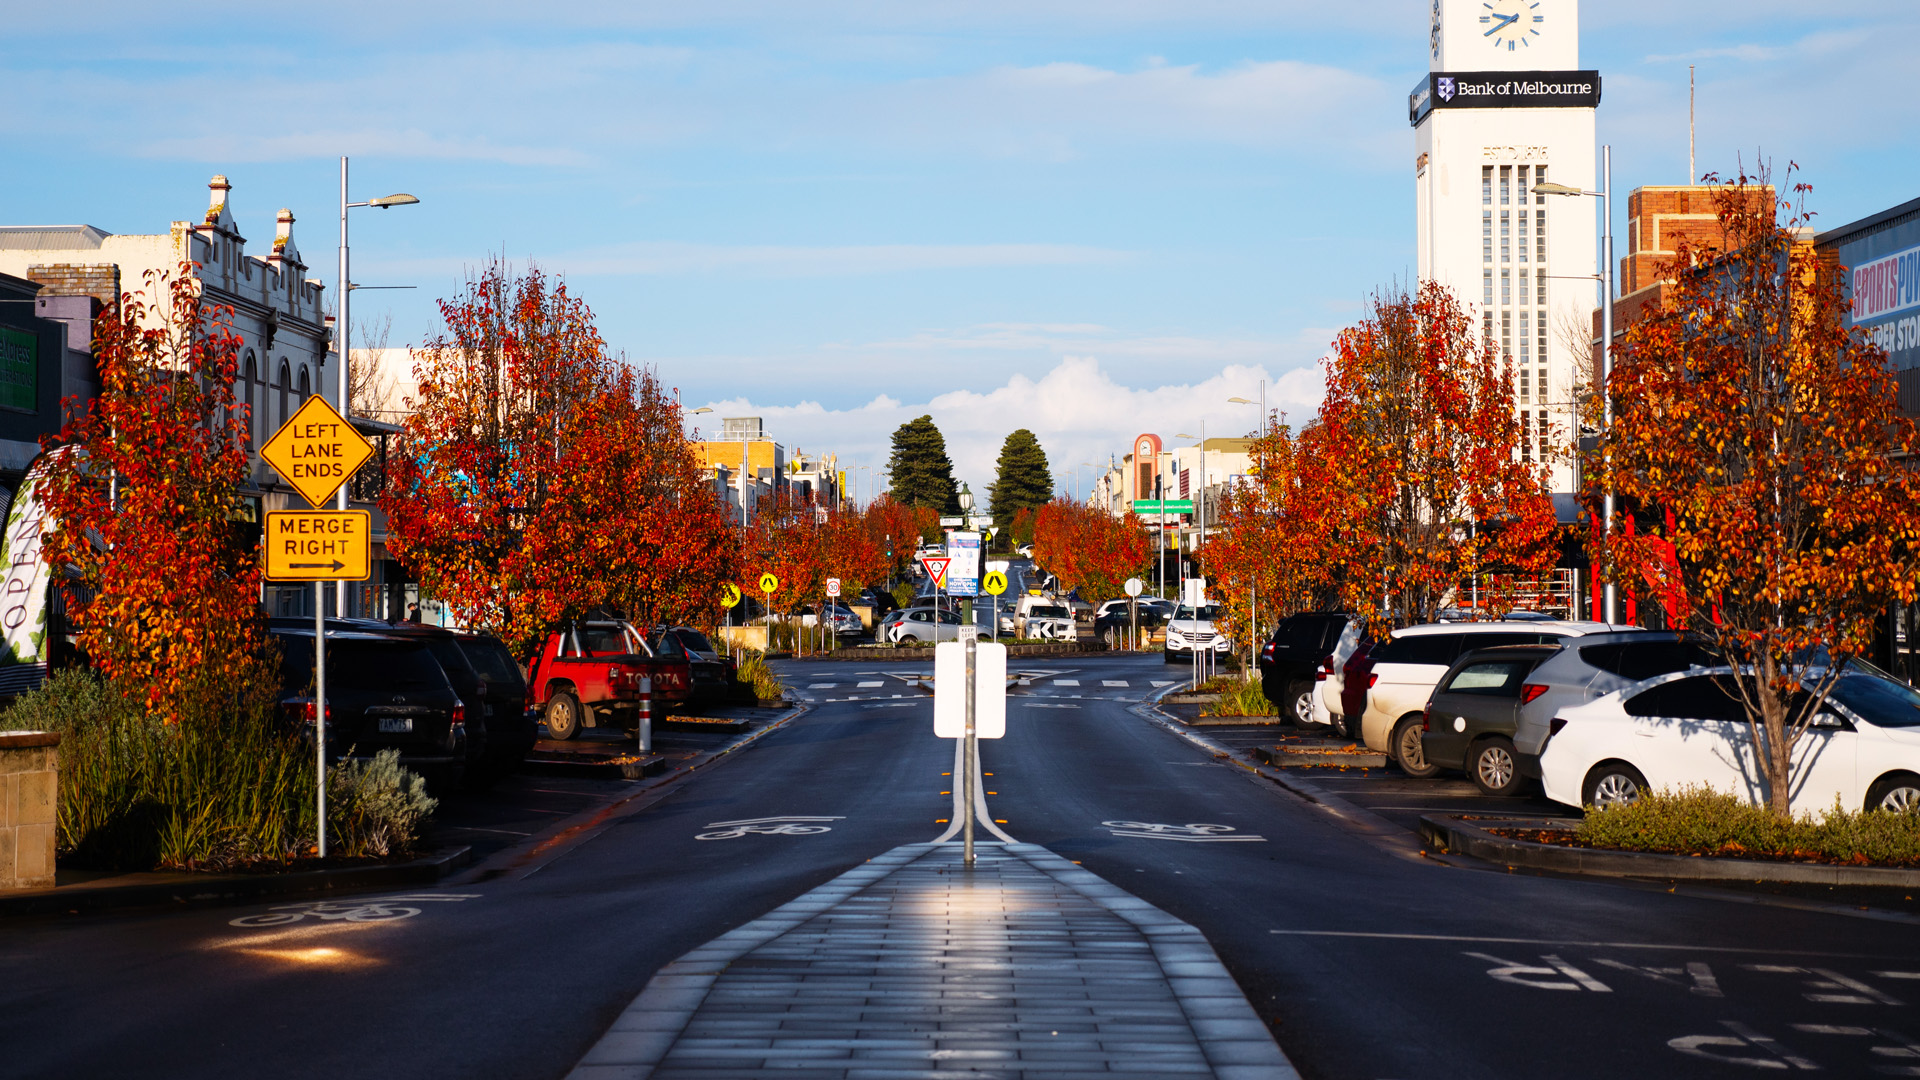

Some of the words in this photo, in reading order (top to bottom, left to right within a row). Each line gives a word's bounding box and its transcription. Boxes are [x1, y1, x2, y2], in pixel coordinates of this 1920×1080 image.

[1458, 82, 1495, 96] Bank
[1496, 82, 1511, 95] of
[1513, 81, 1592, 95] Melbourne
[294, 424, 340, 438] LEFT
[292, 444, 343, 458] LANE
[293, 463, 343, 477] ENDS
[280, 519, 354, 533] MERGE
[285, 540, 349, 554] RIGHT
[4, 518, 41, 630] OPEN
